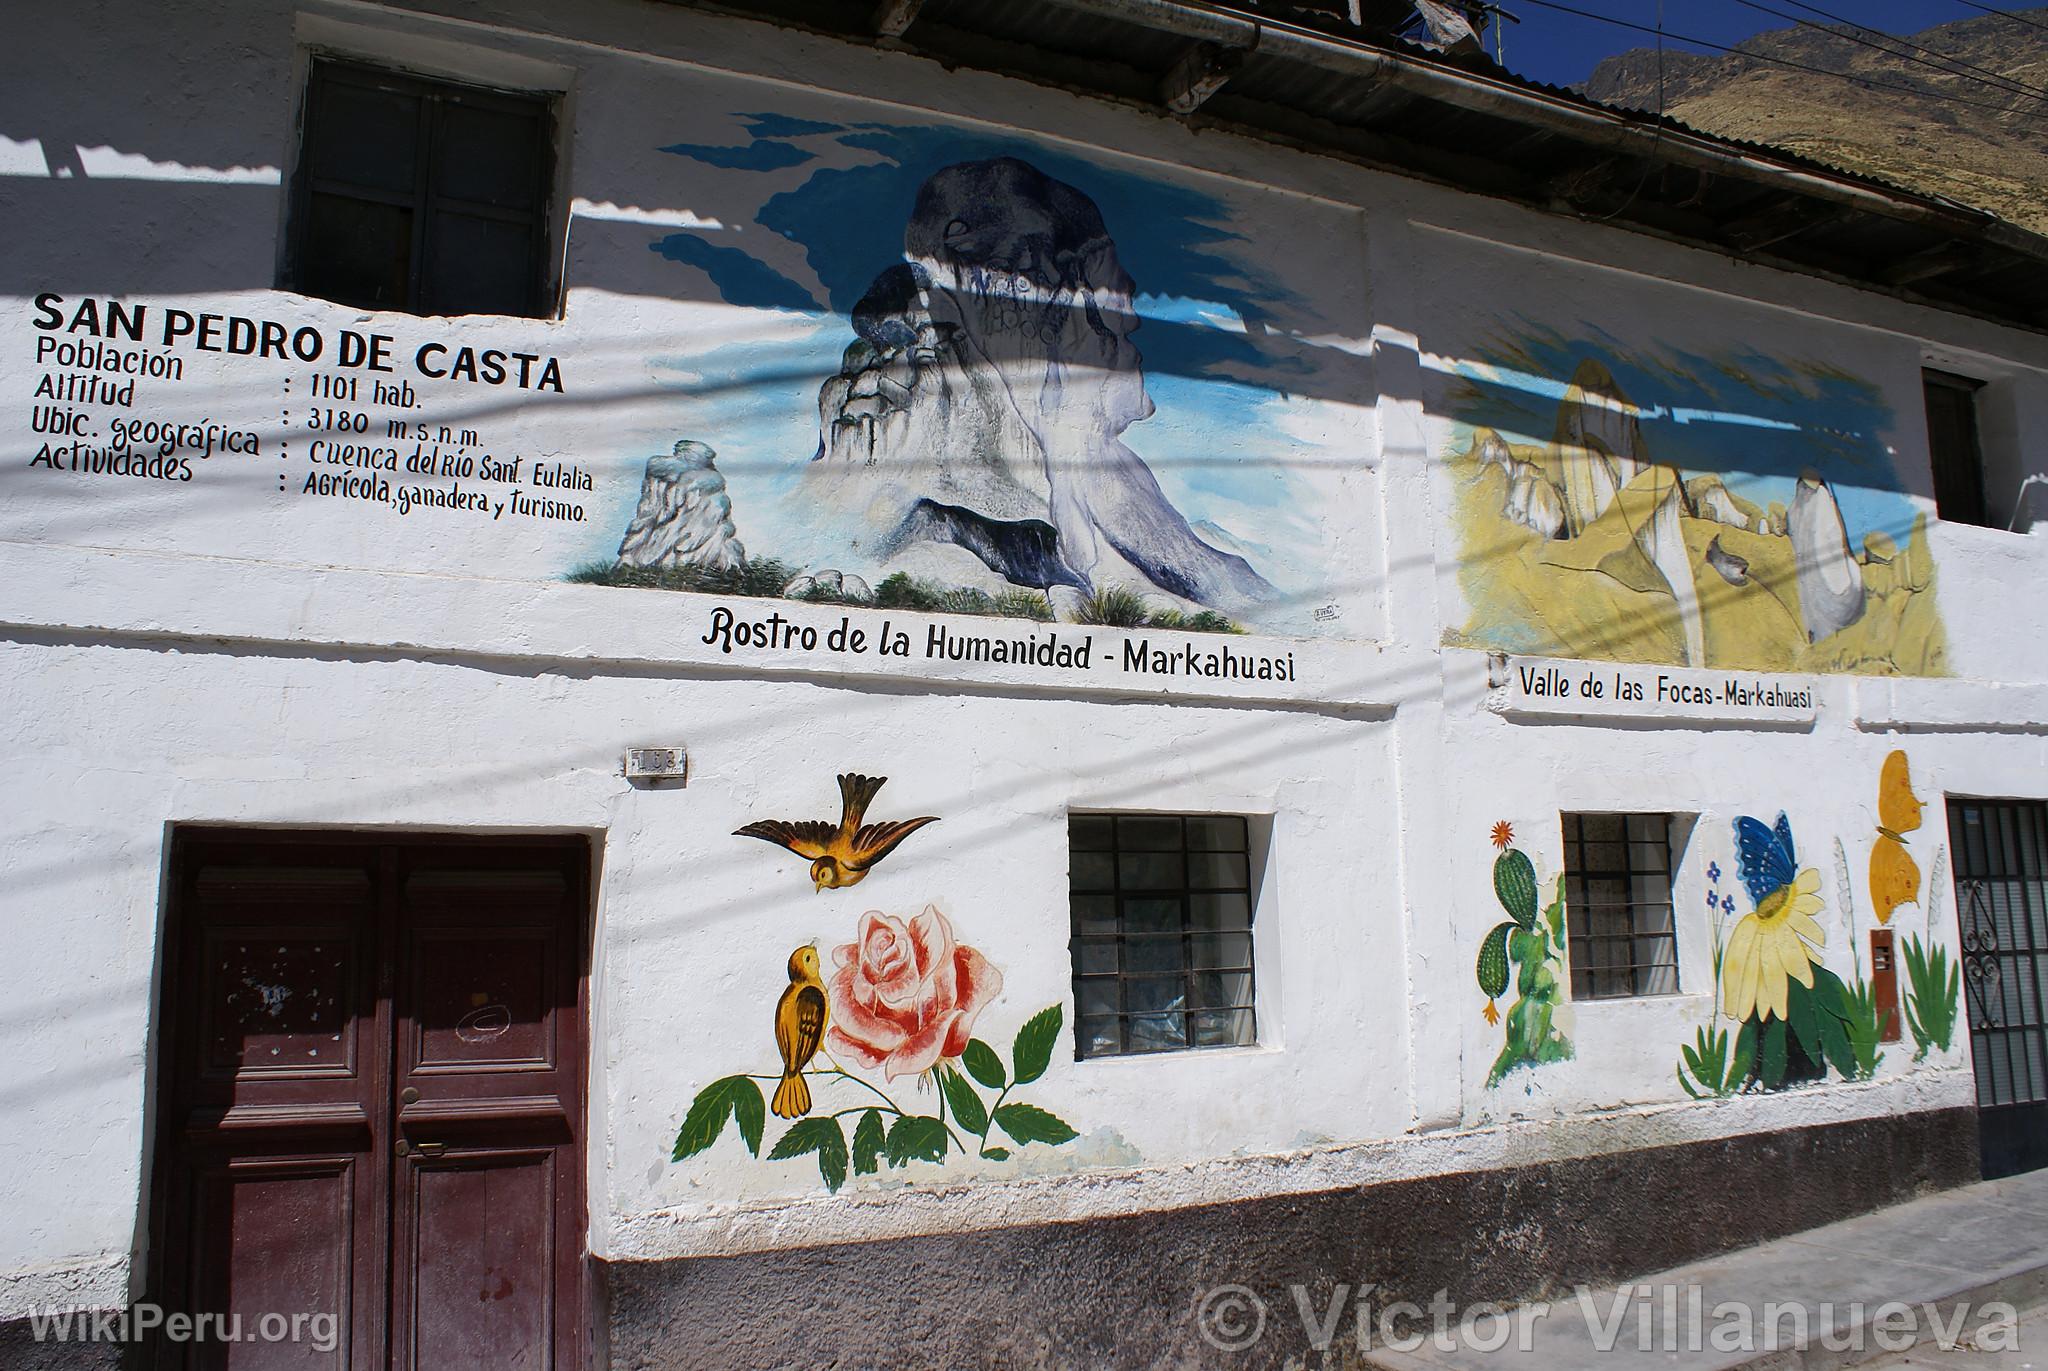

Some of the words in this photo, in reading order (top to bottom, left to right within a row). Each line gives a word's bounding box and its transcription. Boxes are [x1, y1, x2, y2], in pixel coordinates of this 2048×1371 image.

[33, 293, 147, 342] SAN
[162, 308, 324, 363] PEDRO
[338, 329, 394, 373] DE
[415, 342, 565, 394] CASTA
[36, 336, 183, 381] Población
[311, 373, 357, 402] 1101
[373, 379, 422, 409] hab.
[34, 373, 135, 408] Altitud
[29, 440, 193, 482] Actividades
[494, 502, 505, 520] y
[32, 405, 98, 438] Ubic.
[111, 417, 260, 459] geográfica
[406, 443, 438, 475] del
[533, 462, 593, 491] Eulalia
[702, 606, 818, 653] Rostro
[827, 617, 868, 652] de
[879, 620, 910, 657] la
[926, 623, 1092, 669] Humanidad
[1123, 638, 1296, 682] Markahuasi
[1519, 666, 1570, 698] Valle
[1580, 671, 1604, 699] de
[1615, 673, 1644, 701] las
